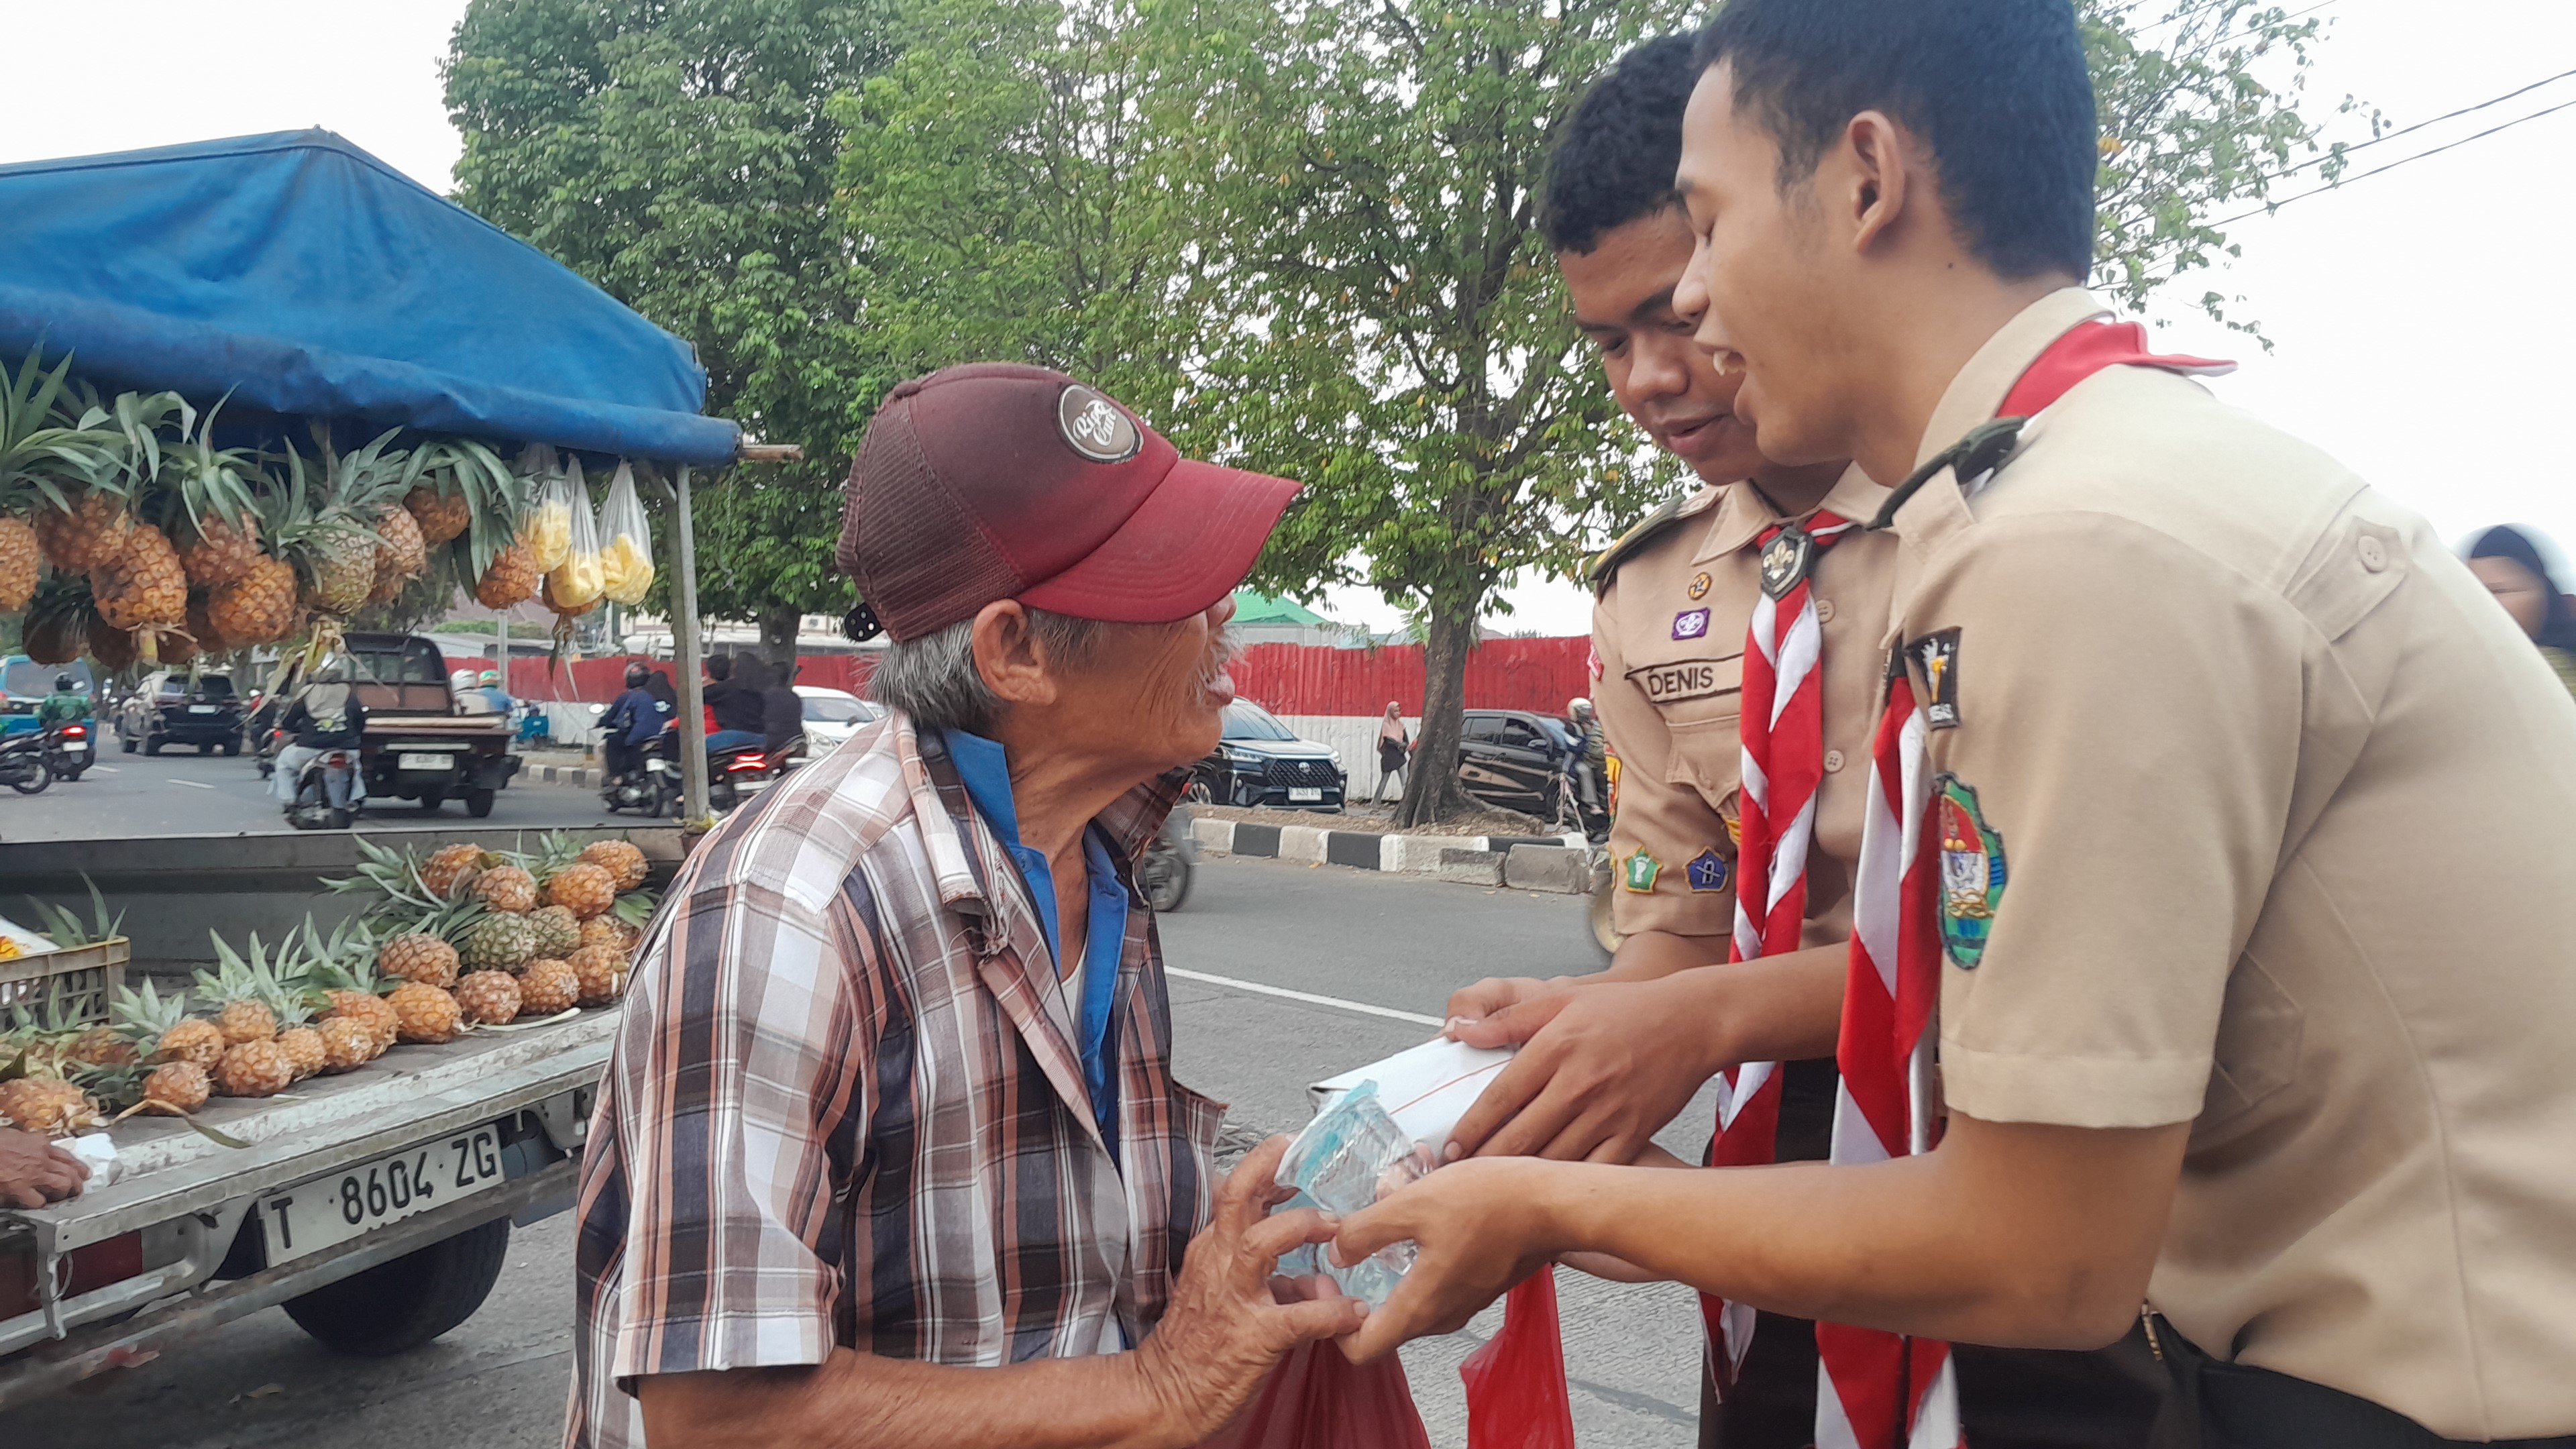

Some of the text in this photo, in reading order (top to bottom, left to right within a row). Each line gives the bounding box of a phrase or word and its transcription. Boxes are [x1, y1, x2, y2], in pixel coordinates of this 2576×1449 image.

[1648, 667, 1713, 695] DENIS
[270, 1132, 497, 1249] T 8604 ZG
